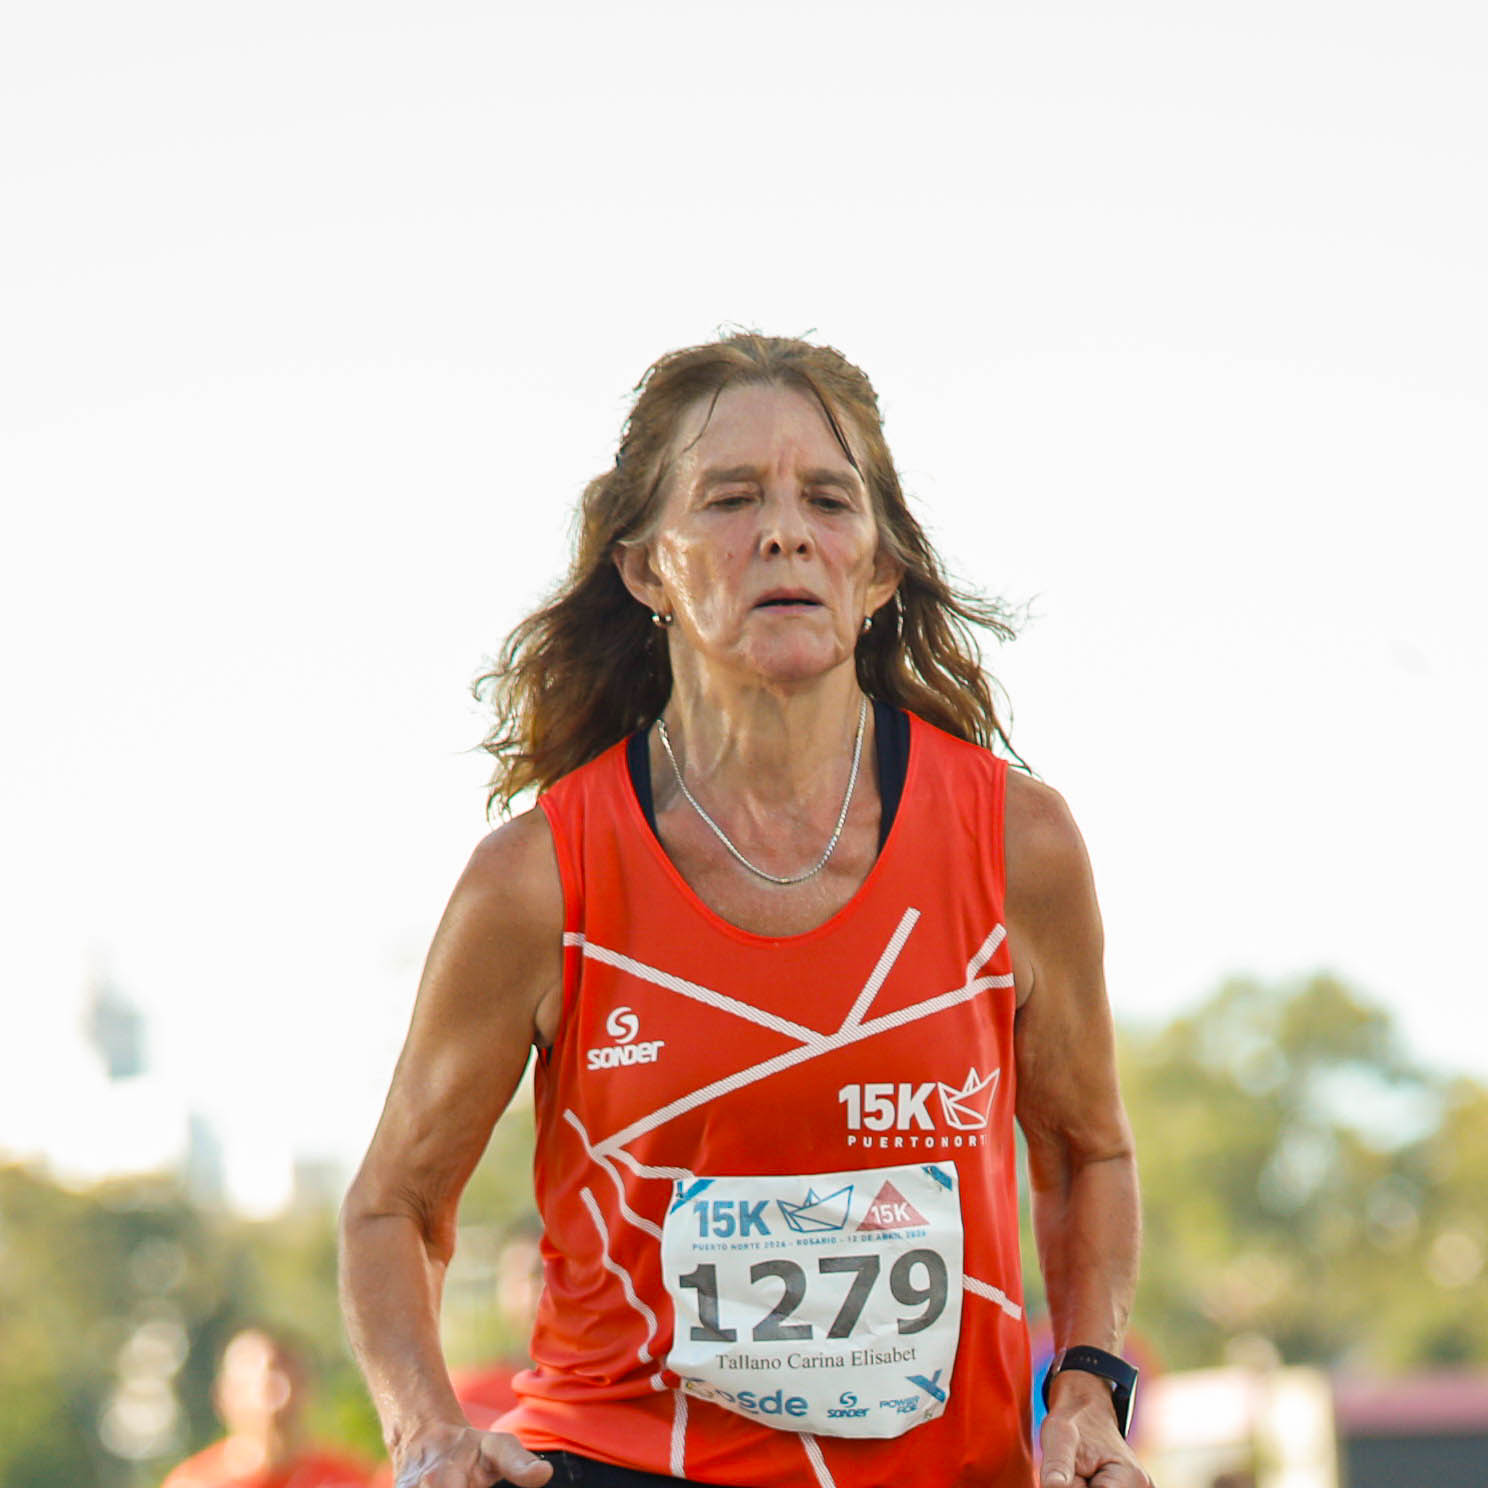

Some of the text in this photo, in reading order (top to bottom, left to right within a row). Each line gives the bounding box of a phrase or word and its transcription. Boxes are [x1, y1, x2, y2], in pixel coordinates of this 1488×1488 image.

[838, 1082, 937, 1131] 15K
[693, 1200, 772, 1238] 15K
[870, 1202, 912, 1225] 15K
[797, 1237, 837, 1246] ROSARIO
[862, 1234, 873, 1242] DE
[679, 1249, 948, 1342] 1279
[715, 1347, 916, 1370] Tallano Carina Elisabet
